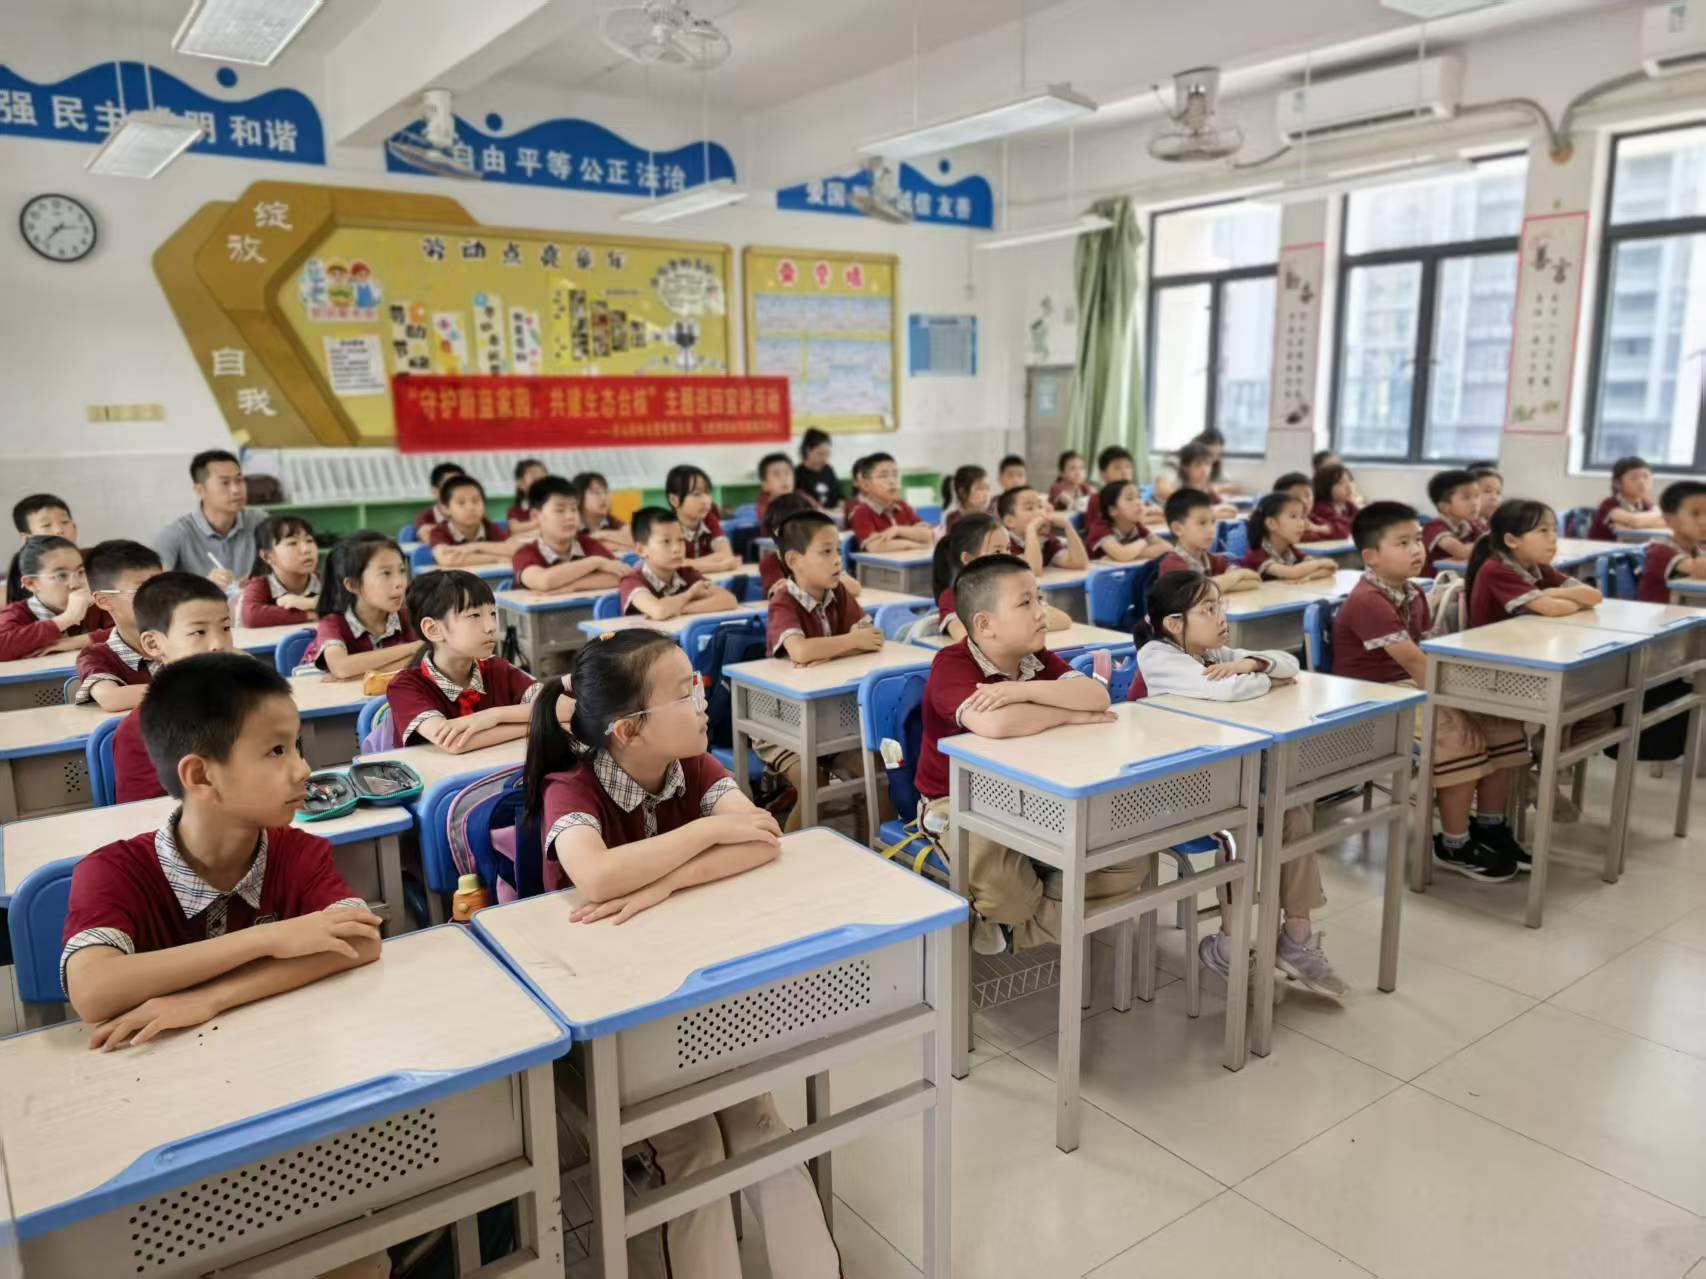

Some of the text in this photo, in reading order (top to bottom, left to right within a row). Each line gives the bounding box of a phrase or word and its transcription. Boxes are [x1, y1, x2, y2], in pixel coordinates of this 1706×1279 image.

[51, 95, 126, 137] 民主
[229, 115, 298, 153] 和谐
[453, 142, 686, 190] 自由 平等 公正 法治
